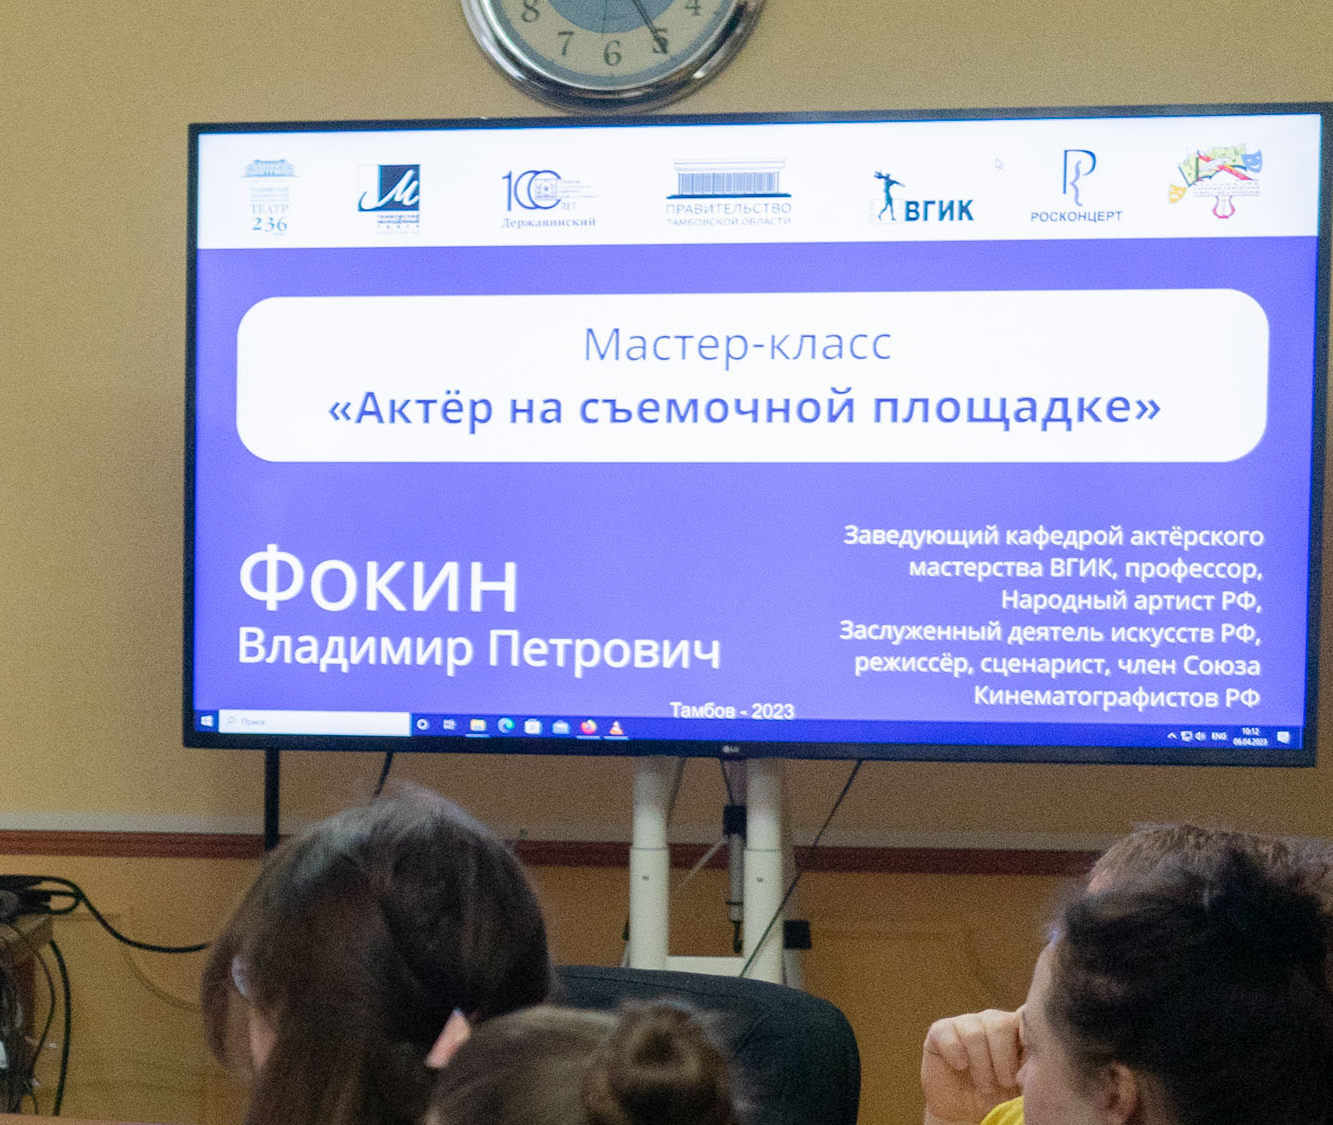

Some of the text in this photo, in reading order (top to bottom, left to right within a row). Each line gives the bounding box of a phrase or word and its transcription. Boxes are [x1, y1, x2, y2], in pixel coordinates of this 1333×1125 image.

[557, 31, 575, 57] 7
[603, 40, 622, 66] 6
[665, 202, 793, 215] ПРАВИТЕЛЬСТВО
[904, 200, 975, 222] ВГИК
[1030, 209, 1123, 224] РОСКОНЦЕРТ
[252, 216, 288, 232] 236
[500, 216, 596, 230] Державинский
[583, 326, 893, 371] Мастер-класс
[328, 386, 1162, 435] «Актёр на съемочной площадке»
[843, 523, 1265, 552] Заведующий кафедрой актёрского
[909, 558, 1264, 585] мастерства ВГИК, профессор,
[1001, 588, 1264, 617] Народный артист РФ,
[839, 620, 1263, 648] Заслуженный деятель искусств РФ,
[237, 625, 721, 678] Владимир Петрович
[854, 652, 1262, 681] режиссёр, сценарист, член Союза
[670, 701, 735, 720] Тамбов
[752, 703, 795, 720] 2023
[974, 684, 1261, 714] Кинематографистов РФ
[1211, 731, 1228, 741] ENG
